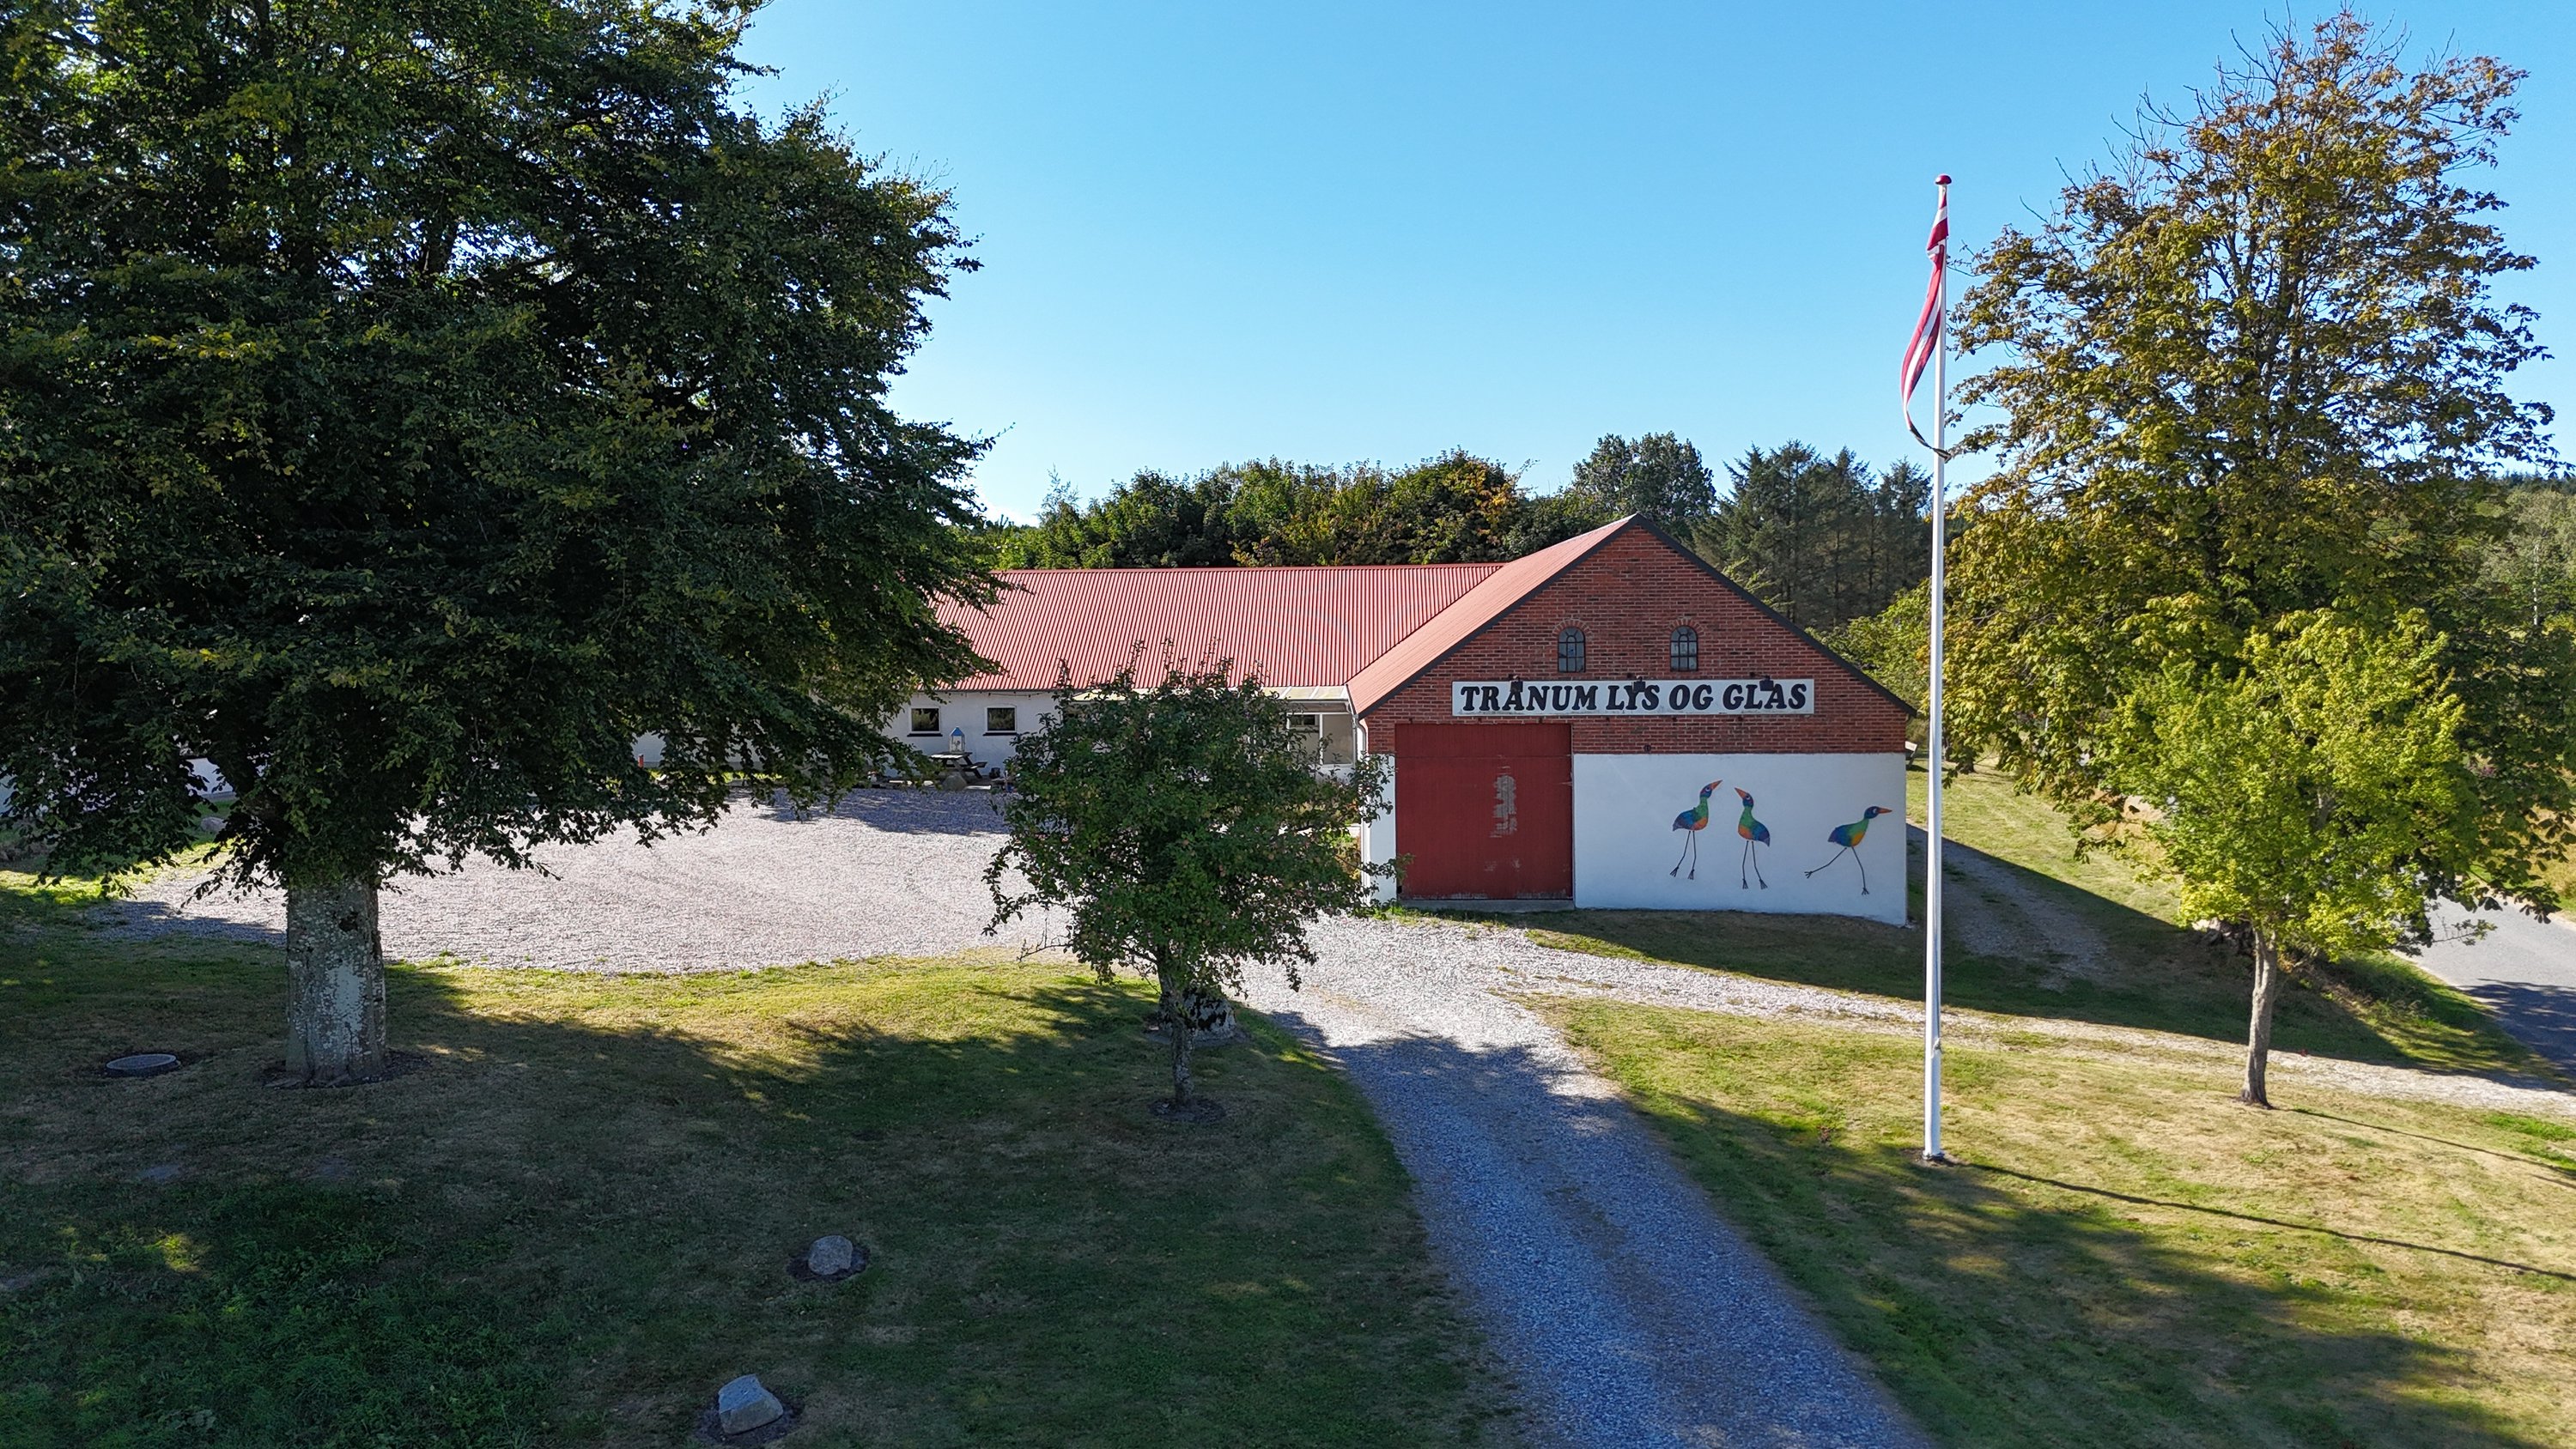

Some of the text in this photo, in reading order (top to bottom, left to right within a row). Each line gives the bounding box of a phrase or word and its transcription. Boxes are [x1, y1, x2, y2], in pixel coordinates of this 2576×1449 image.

[1606, 684, 1660, 711] LYS
[1668, 684, 1714, 710] OG
[1722, 683, 1807, 710] GLAS
